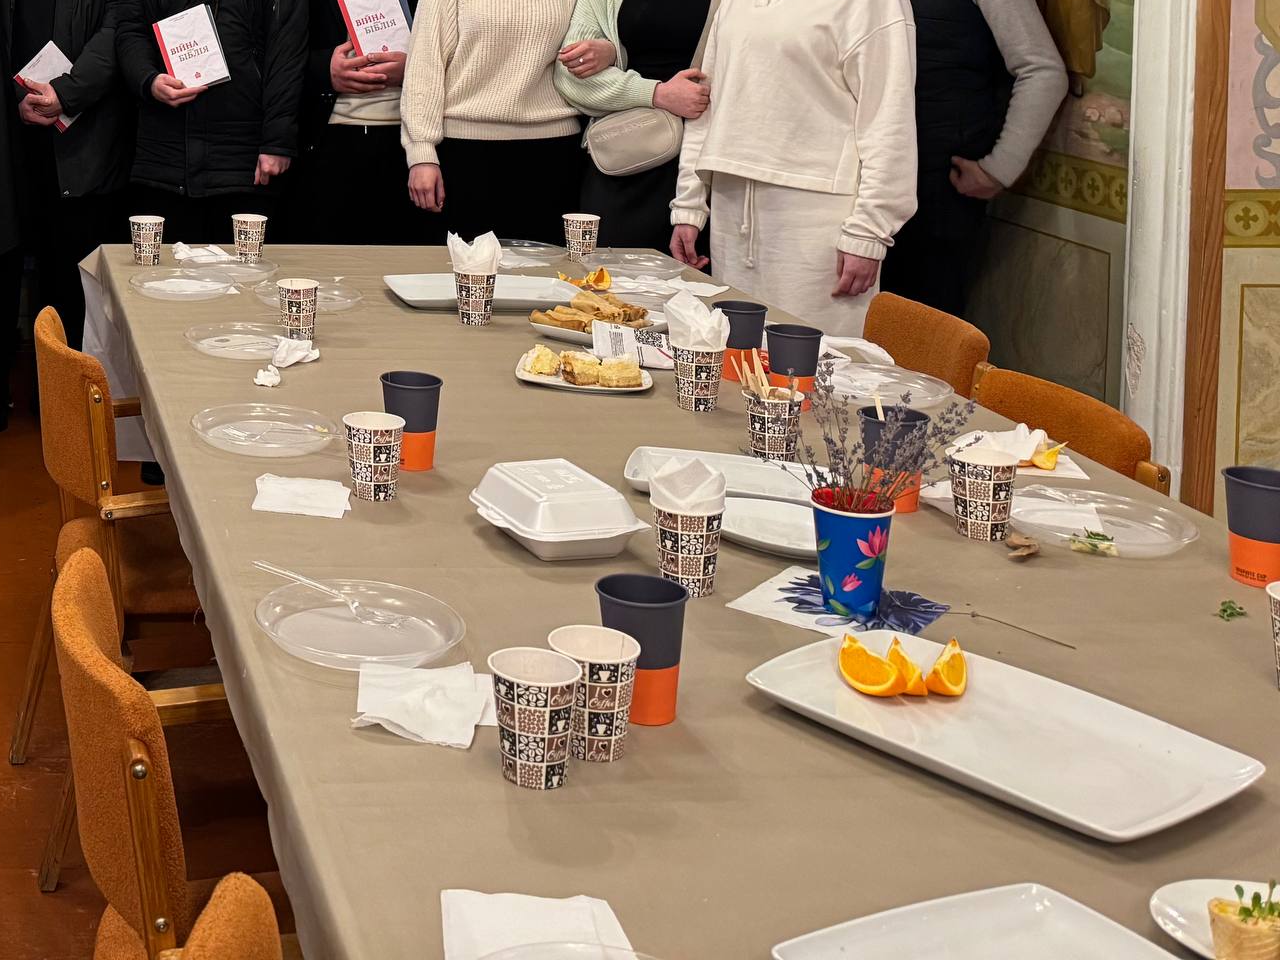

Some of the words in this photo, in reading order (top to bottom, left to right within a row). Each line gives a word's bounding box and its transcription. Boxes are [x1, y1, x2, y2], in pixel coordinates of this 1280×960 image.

[355, 12, 386, 27] ВІЙНА
[364, 18, 397, 34] БІБЛІЯ
[170, 40, 199, 56] ВІЙНА
[178, 45, 210, 62] БІБЛІЯ
[588, 697, 616, 709] Coffee
[587, 750, 610, 761] Coffee
